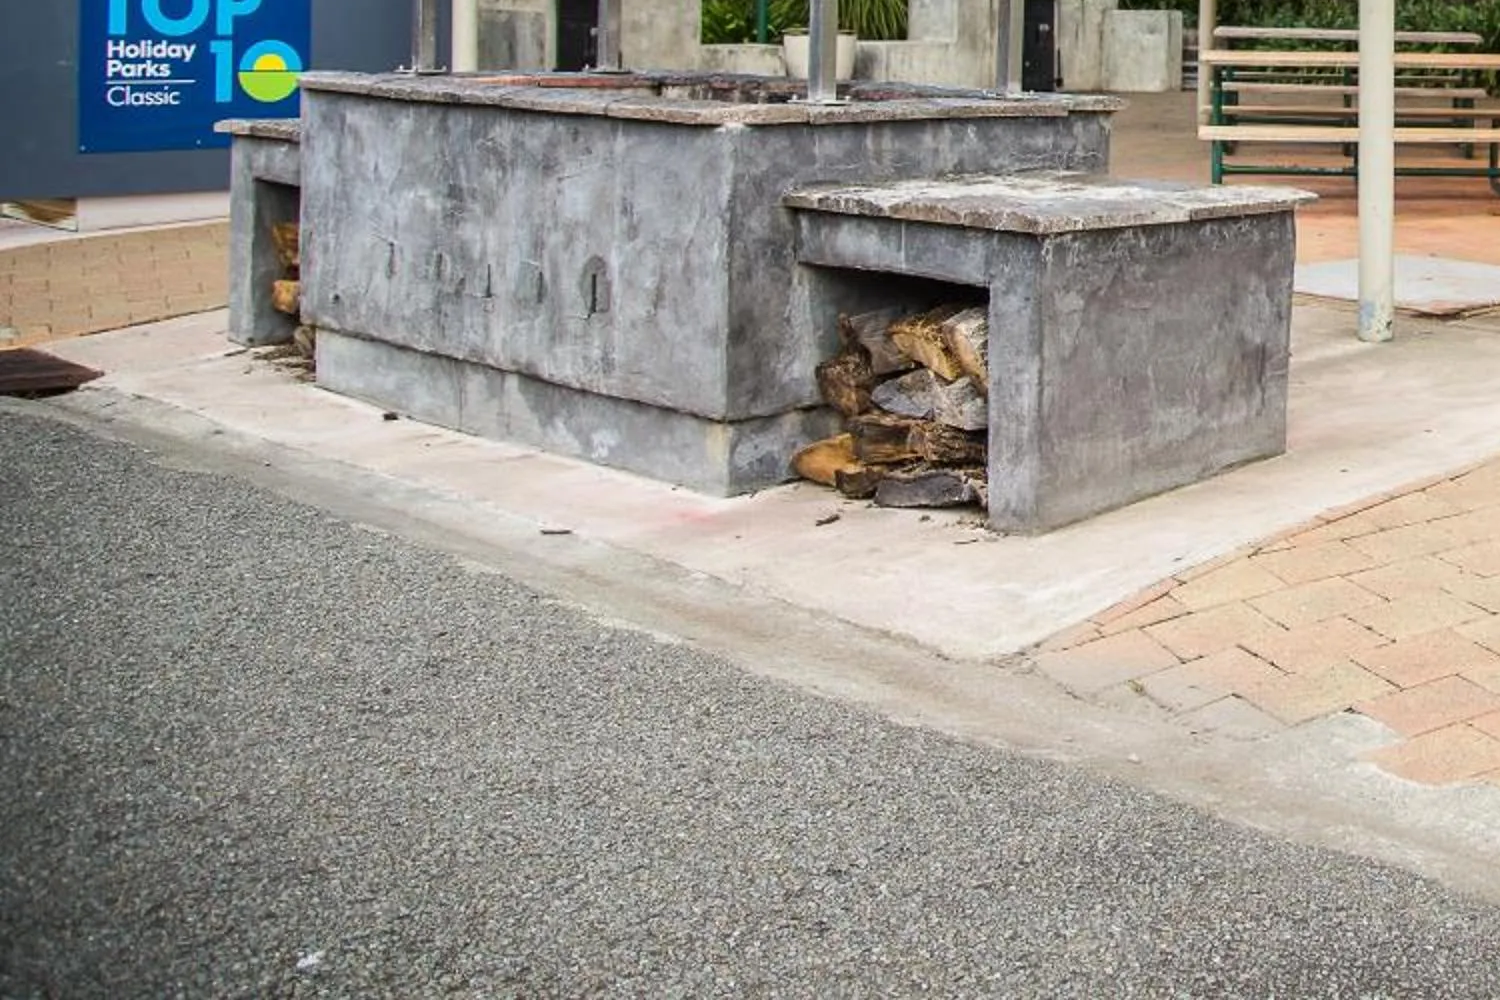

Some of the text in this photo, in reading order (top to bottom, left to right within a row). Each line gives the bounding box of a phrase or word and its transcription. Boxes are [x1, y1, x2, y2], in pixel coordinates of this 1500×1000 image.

[107, 40, 196, 62] Holiday
[107, 61, 171, 77] Parks
[210, 40, 302, 103] 10
[106, 86, 180, 106] Classic
